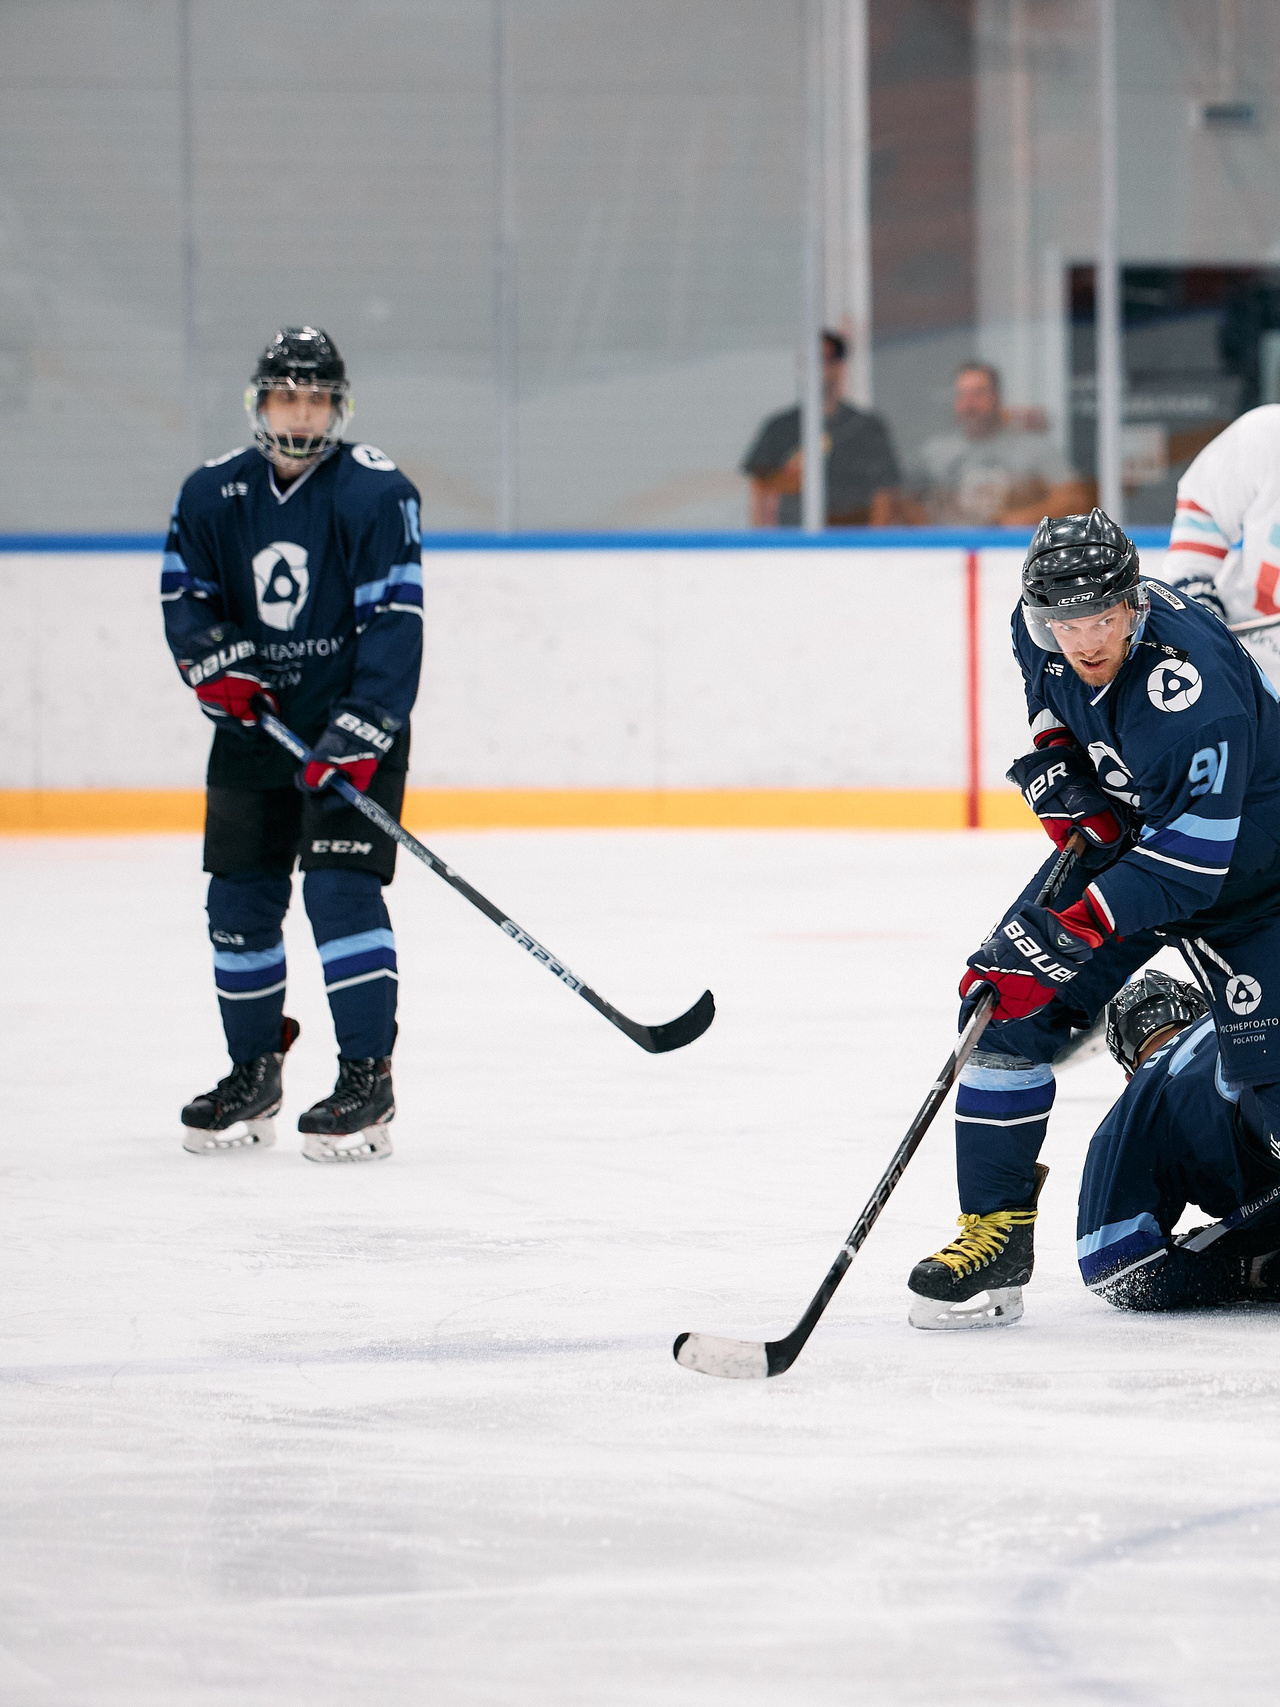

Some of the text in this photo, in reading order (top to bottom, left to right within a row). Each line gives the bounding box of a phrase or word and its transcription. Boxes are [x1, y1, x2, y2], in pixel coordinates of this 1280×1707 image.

[1058, 592, 1095, 606] CCM
[1188, 740, 1229, 798] 91
[311, 839, 373, 855] CCM
[1232, 1033, 1266, 1046] РОСАТОМ
